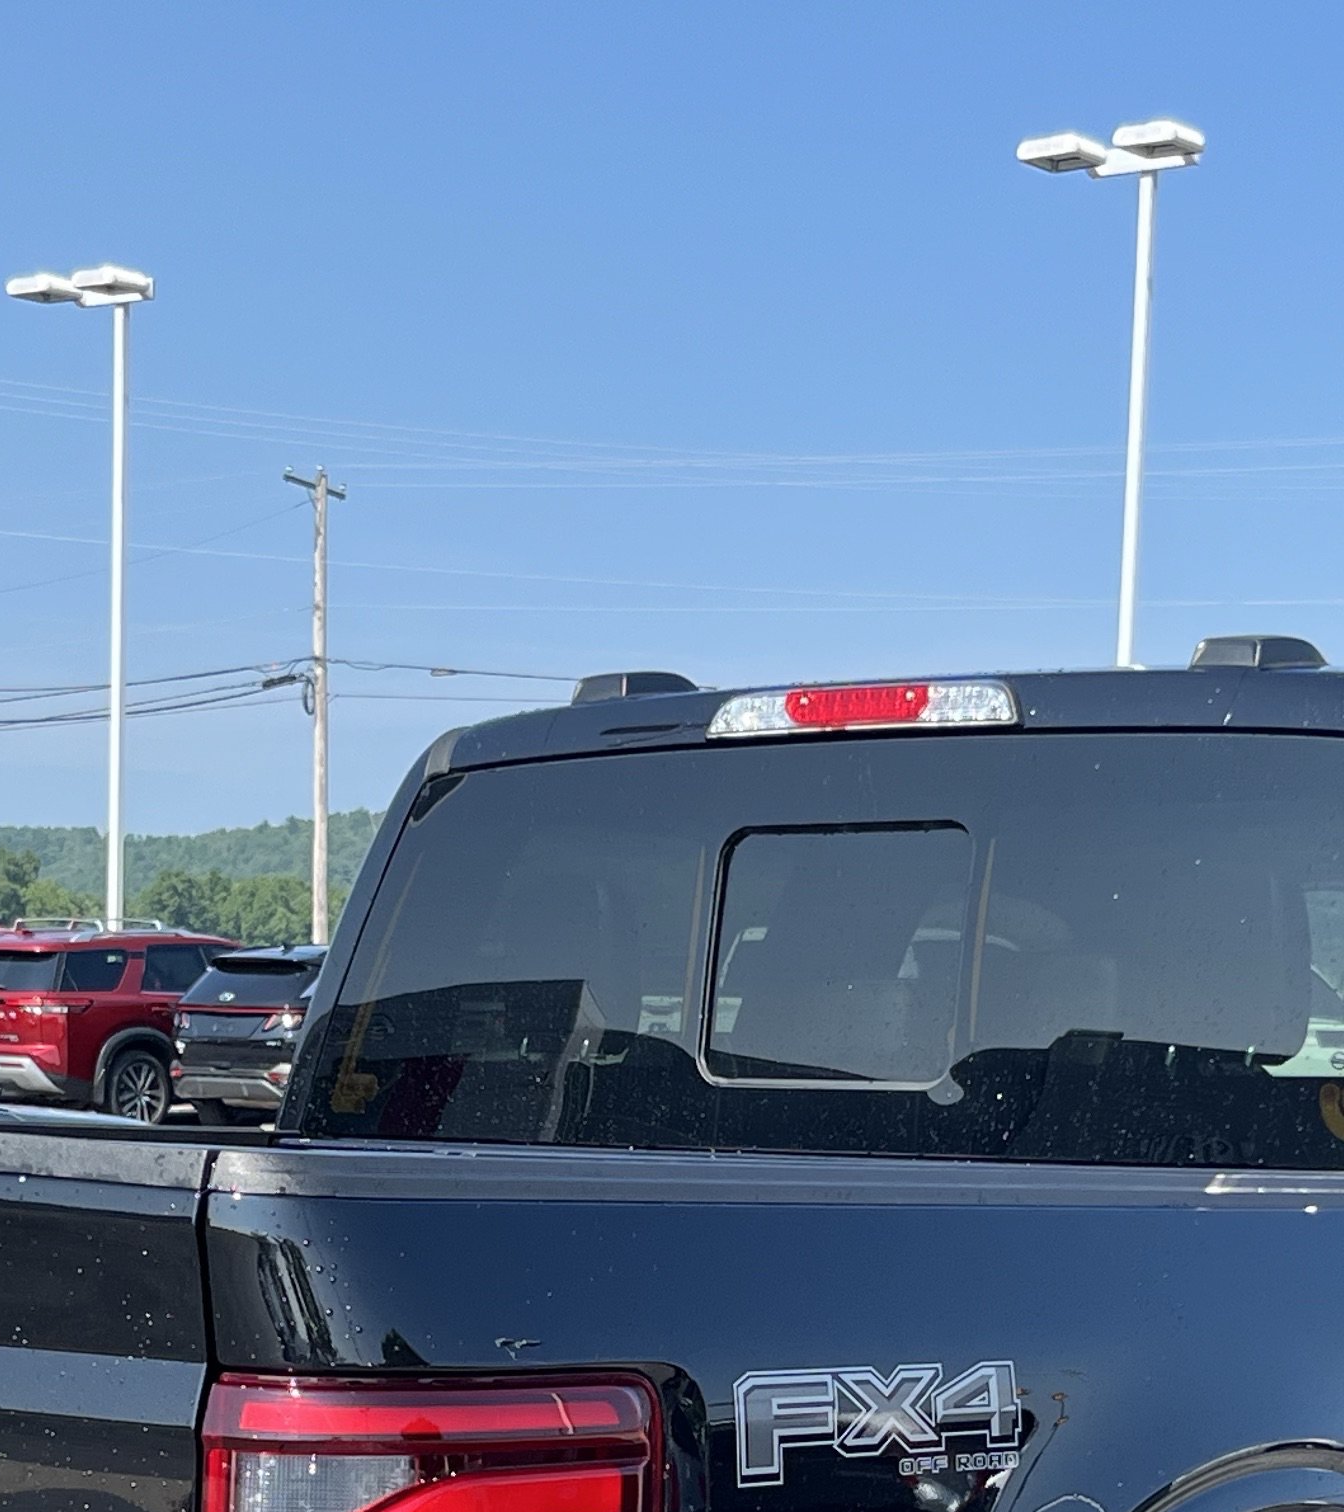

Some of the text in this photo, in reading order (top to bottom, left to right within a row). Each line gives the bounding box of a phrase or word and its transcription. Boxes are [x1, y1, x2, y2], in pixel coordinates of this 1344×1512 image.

[732, 1360, 1022, 1489] FX4
[898, 1451, 1020, 1477] OFF ROAD
